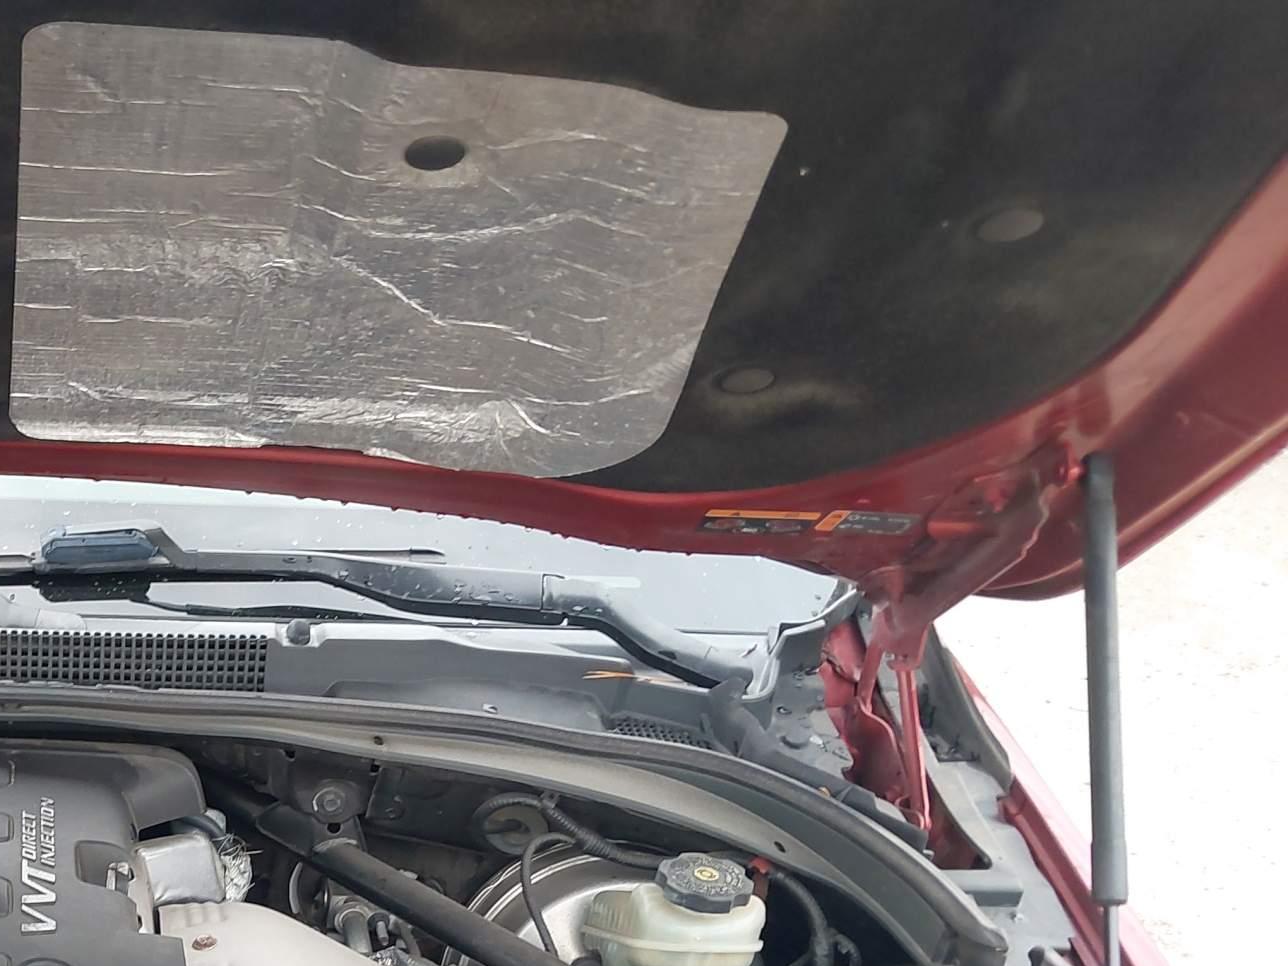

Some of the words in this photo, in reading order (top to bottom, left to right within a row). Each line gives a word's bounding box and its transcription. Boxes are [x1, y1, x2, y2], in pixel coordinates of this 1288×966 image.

[22, 810, 37, 861] DIRECT
[40, 797, 56, 867] INJECTION
[21, 859, 57, 932] VVT
